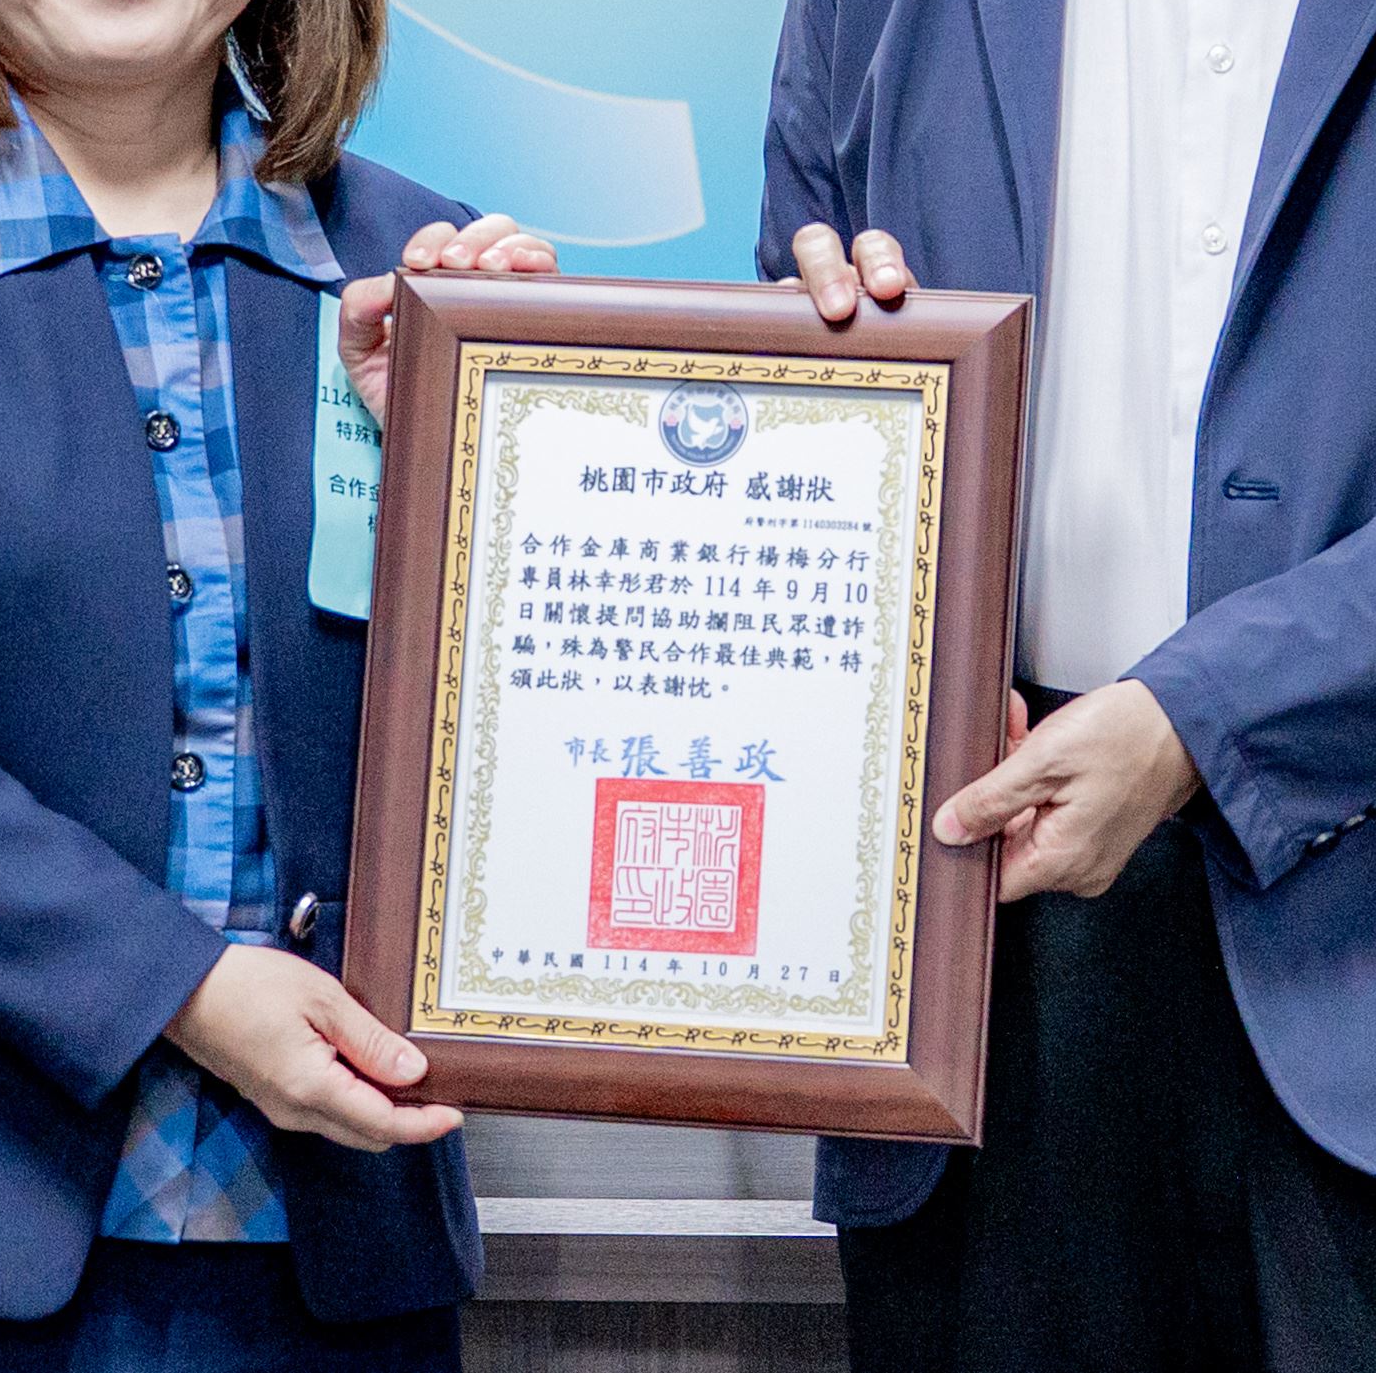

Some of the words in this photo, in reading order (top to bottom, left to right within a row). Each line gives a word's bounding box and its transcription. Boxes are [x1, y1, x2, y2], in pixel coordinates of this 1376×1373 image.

[578, 464, 729, 499] 桃園市政府
[745, 471, 836, 503] 感謝狀
[520, 532, 871, 572] 合作金庫商業銀行楊梅分行
[564, 736, 612, 768] 市長
[621, 734, 787, 782] 張善政
